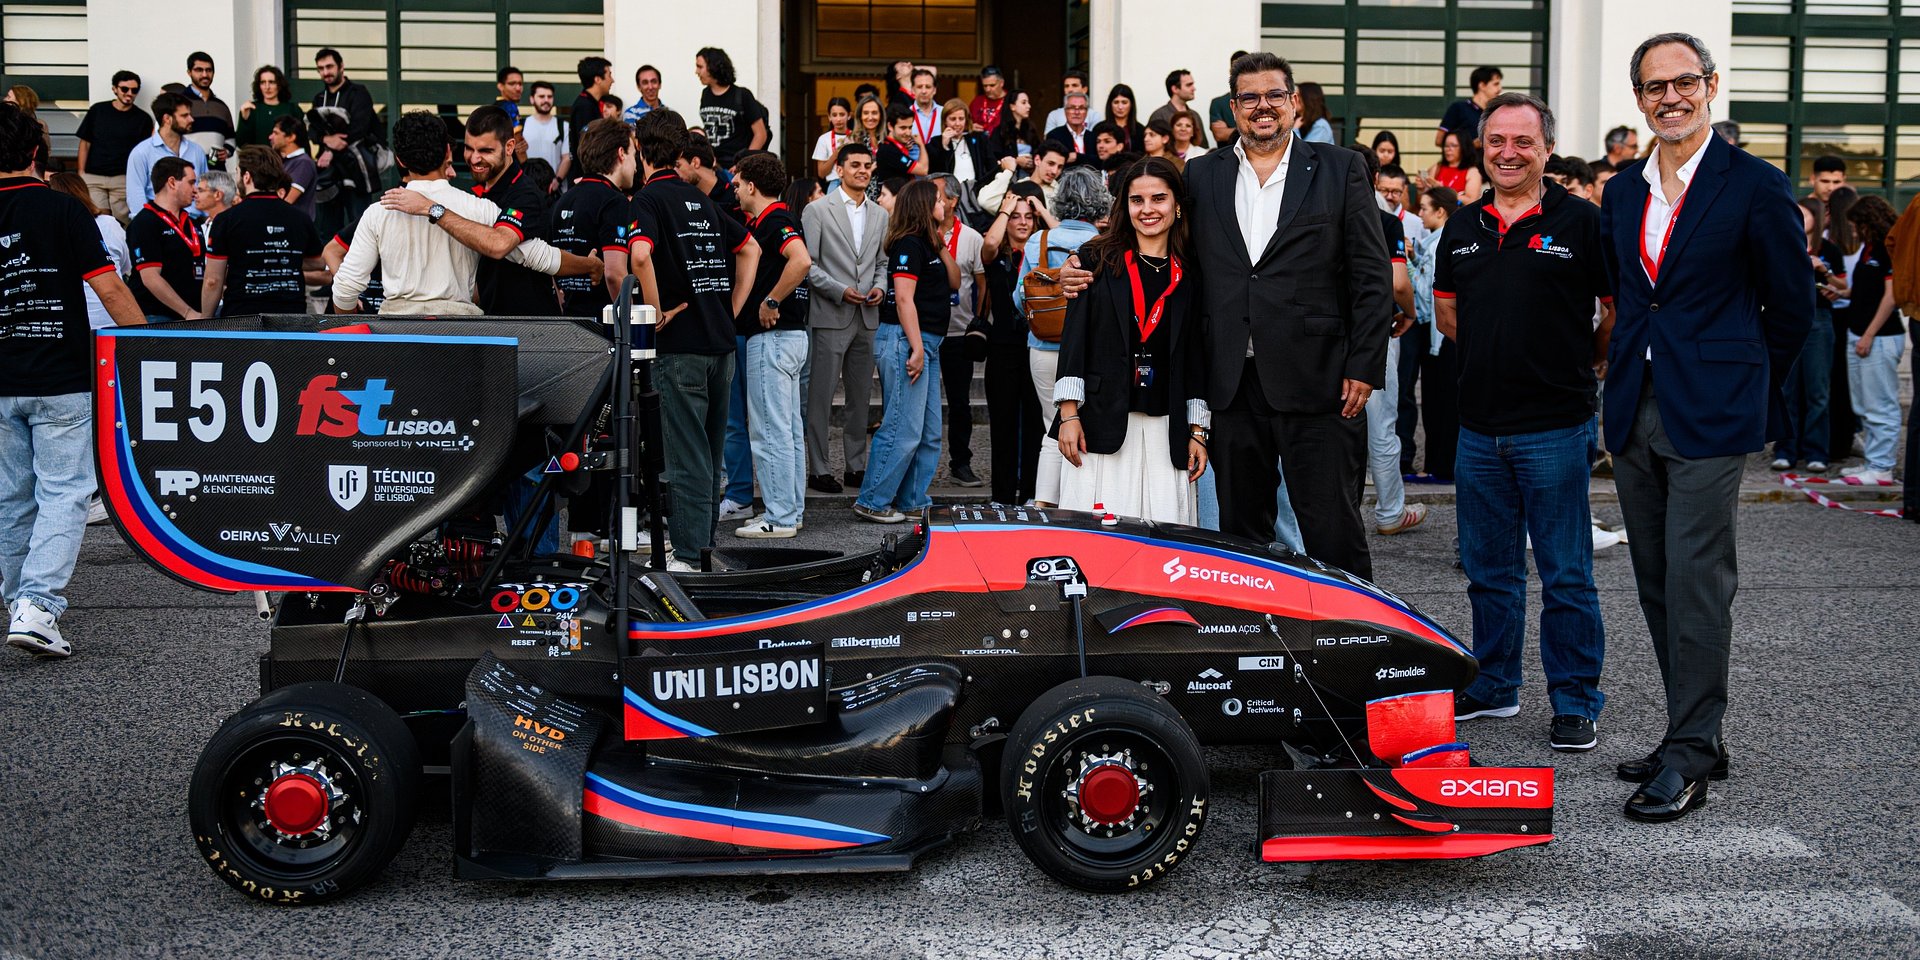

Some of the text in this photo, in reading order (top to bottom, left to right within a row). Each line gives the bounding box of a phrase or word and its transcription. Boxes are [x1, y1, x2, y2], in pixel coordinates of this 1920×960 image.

[140, 361, 279, 443] E50
[296, 375, 395, 438] fst
[386, 420, 457, 435] LISBOA
[352, 440, 400, 450] Sponsored
[401, 440, 413, 449] by
[202, 474, 276, 484] MAINTENANCE
[373, 467, 435, 484] TÉCNICO
[155, 470, 200, 496] TAP
[211, 485, 275, 495] ENGINEERING
[374, 485, 435, 494] UNIVERSIDADE
[374, 494, 415, 502] DE LISBOA
[220, 530, 341, 545] OEIRAS VALLEY
[555, 612, 573, 620] 24V
[1198, 625, 1261, 635] RAMADA AÇOS
[840, 635, 900, 647] Ribermold
[1316, 637, 1336, 646] MD
[1258, 658, 1280, 668] CIN
[1388, 666, 1426, 679] Simoldes
[653, 658, 819, 701] UNI LISBON
[1187, 681, 1232, 690] Alucoat
[515, 715, 566, 741] HVD
[512, 730, 562, 750] ON OTHER
[523, 742, 546, 754] SIDE
[1017, 708, 1096, 803] Hoosier
[1440, 780, 1539, 797] axians
